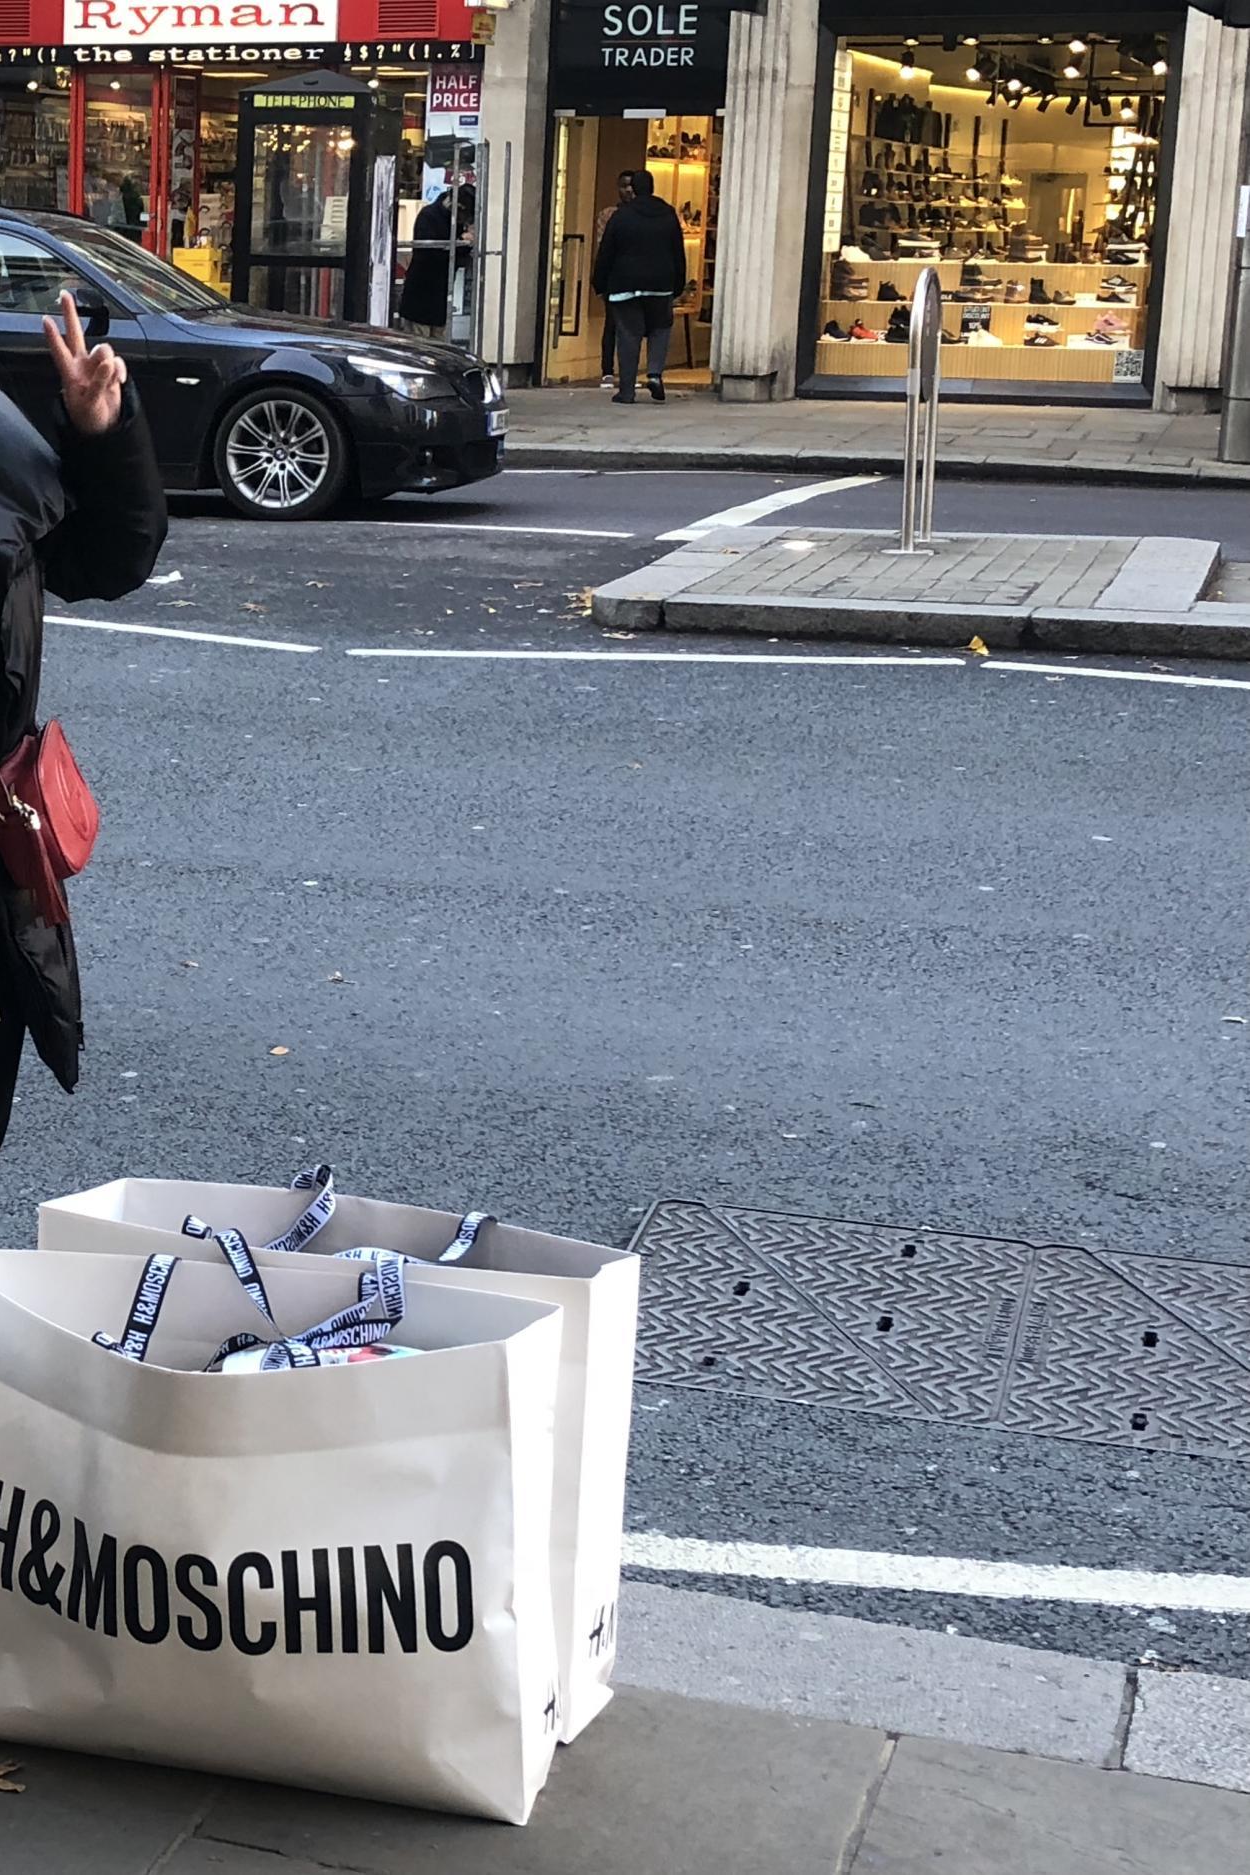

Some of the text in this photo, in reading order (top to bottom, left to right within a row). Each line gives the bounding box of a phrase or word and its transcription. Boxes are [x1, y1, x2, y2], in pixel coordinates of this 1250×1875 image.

[73, 0, 325, 36] Ryman
[602, 4, 699, 36] SOLE
[74, 44, 325, 63] the stationer
[601, 47, 695, 67] TRADER
[435, 75, 478, 90] HALF
[263, 95, 346, 108] TELEPHONE
[432, 92, 479, 108] PRICE
